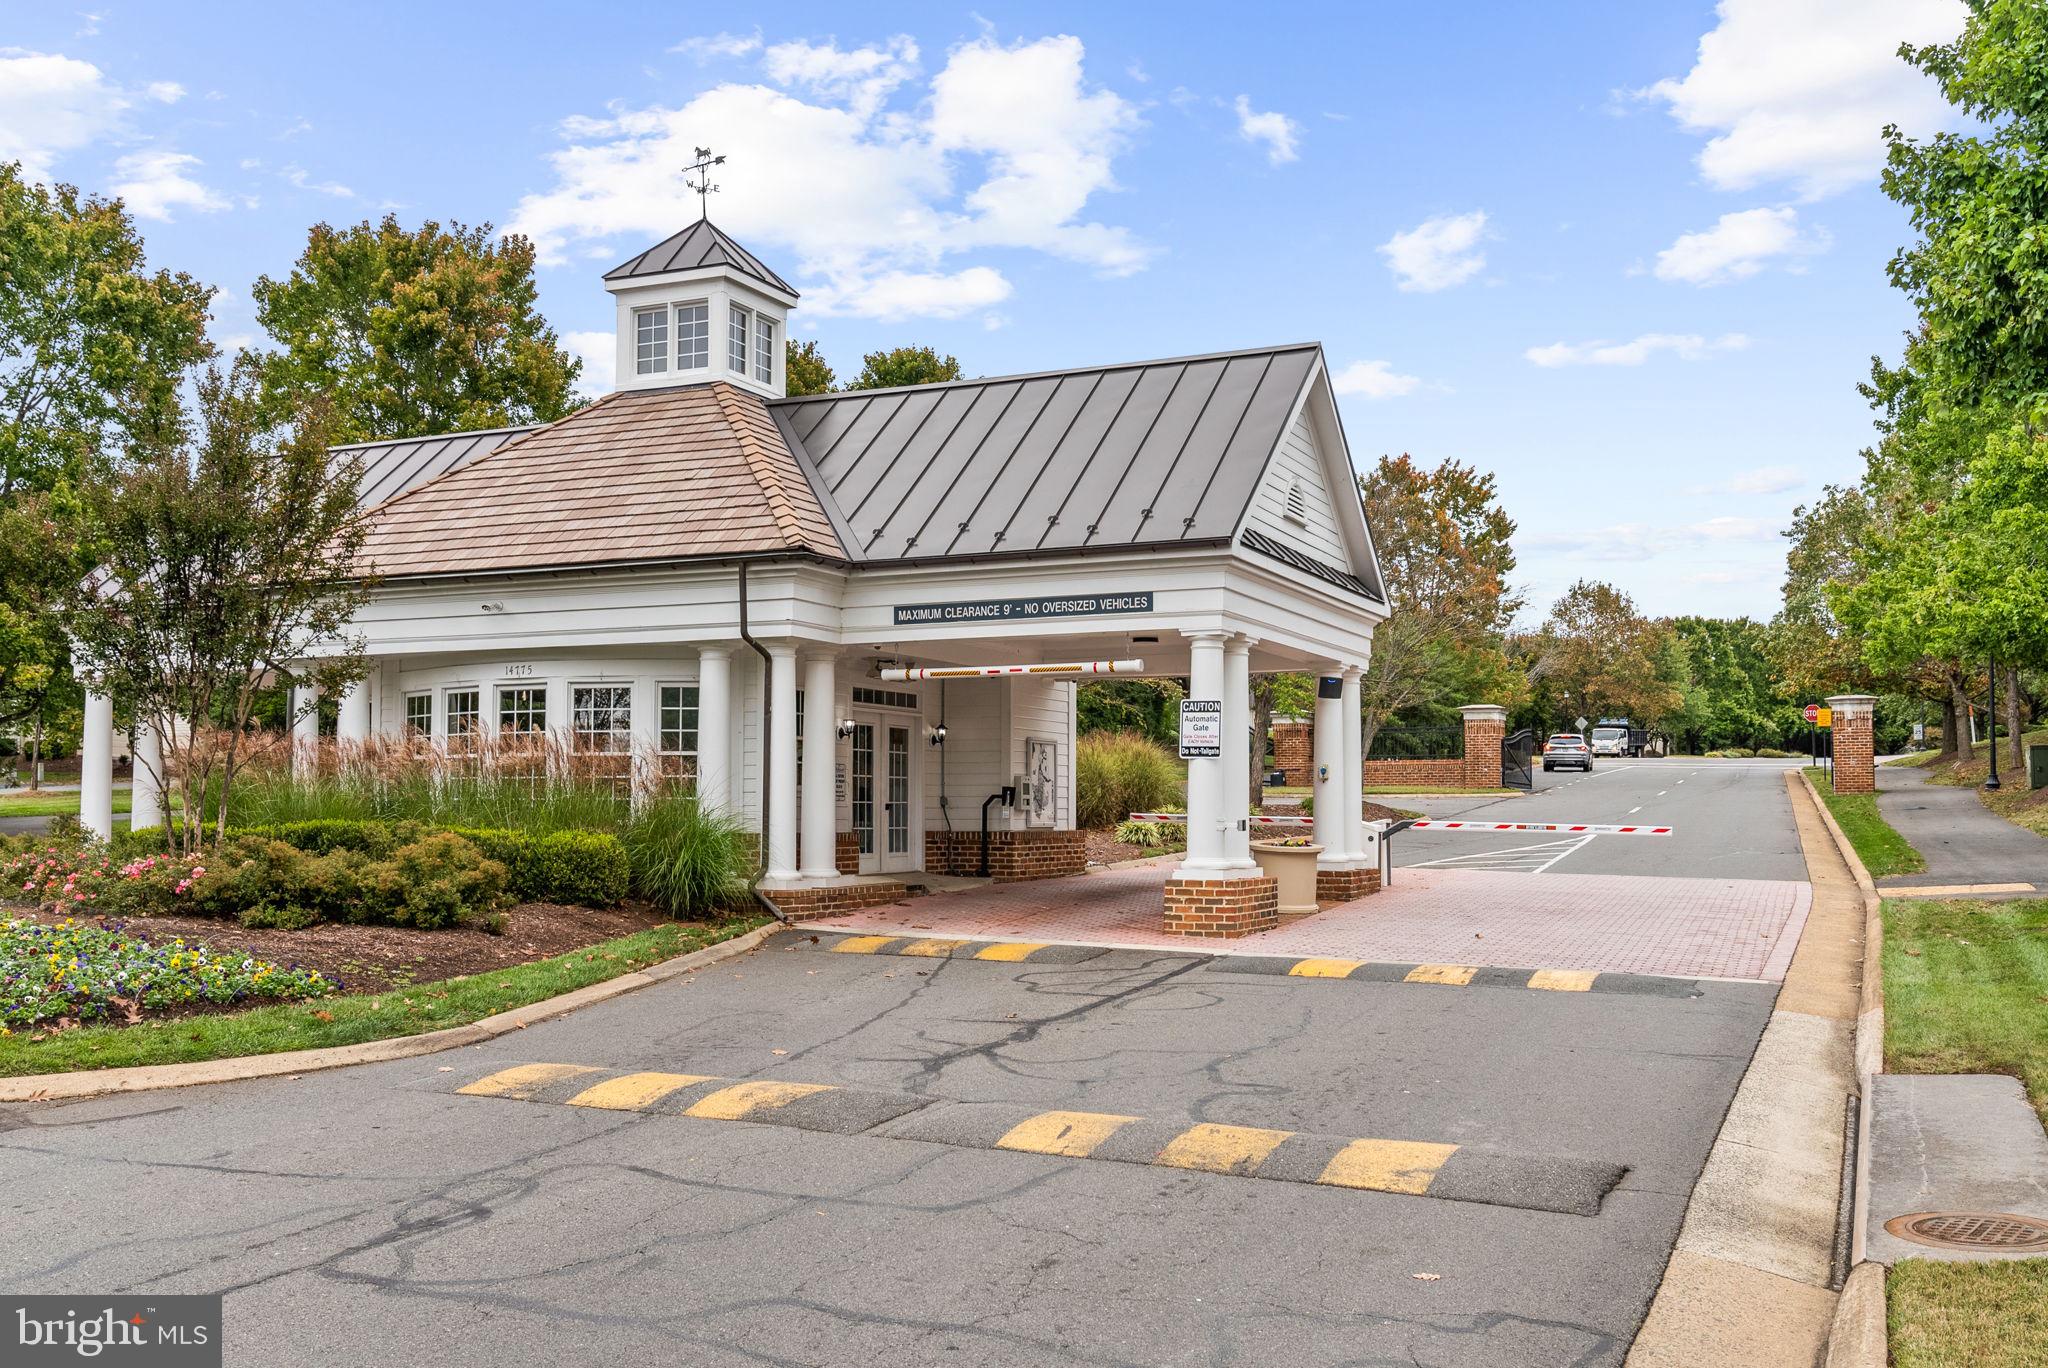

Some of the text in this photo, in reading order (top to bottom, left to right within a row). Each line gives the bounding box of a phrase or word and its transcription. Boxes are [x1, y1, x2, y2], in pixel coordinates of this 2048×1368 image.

[898, 608, 942, 621] MAXIMUM
[944, 605, 1000, 619] CLEARANCE
[1024, 603, 1039, 614] NO
[1042, 600, 1096, 613] OVERSIZED
[1100, 597, 1148, 610] VEHICLES
[505, 664, 533, 676] 14775
[1183, 702, 1220, 711] CAUTION
[1184, 715, 1218, 723] Automatic
